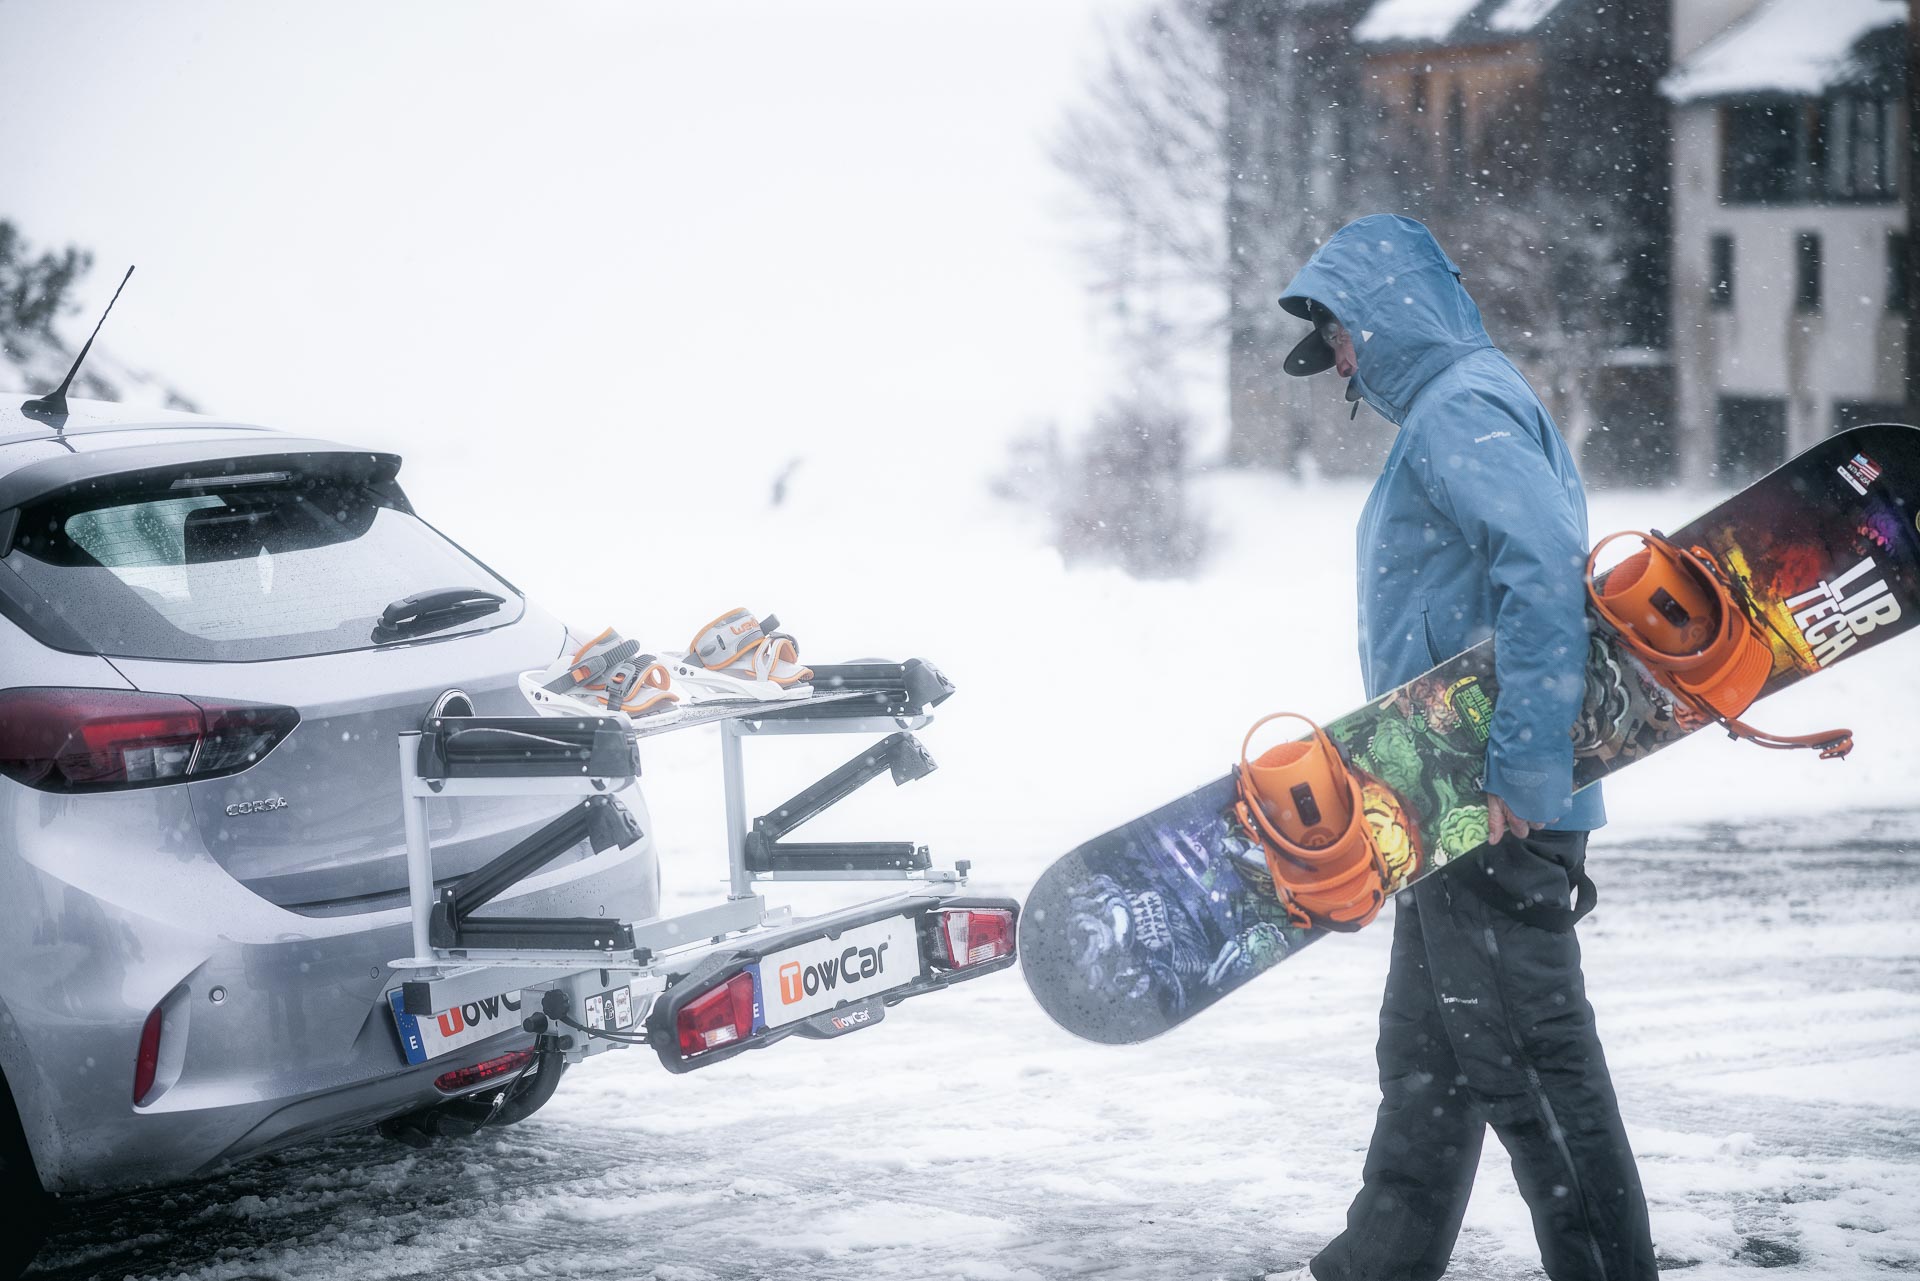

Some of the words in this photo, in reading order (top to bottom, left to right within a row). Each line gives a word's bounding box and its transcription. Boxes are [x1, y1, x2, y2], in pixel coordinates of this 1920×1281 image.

[1829, 556, 1901, 635] LIB
[1786, 580, 1858, 667] TECH
[226, 797, 287, 816] CORSA
[779, 942, 889, 1005] TowCar
[753, 1003, 759, 1018] E
[409, 1035, 418, 1050] E
